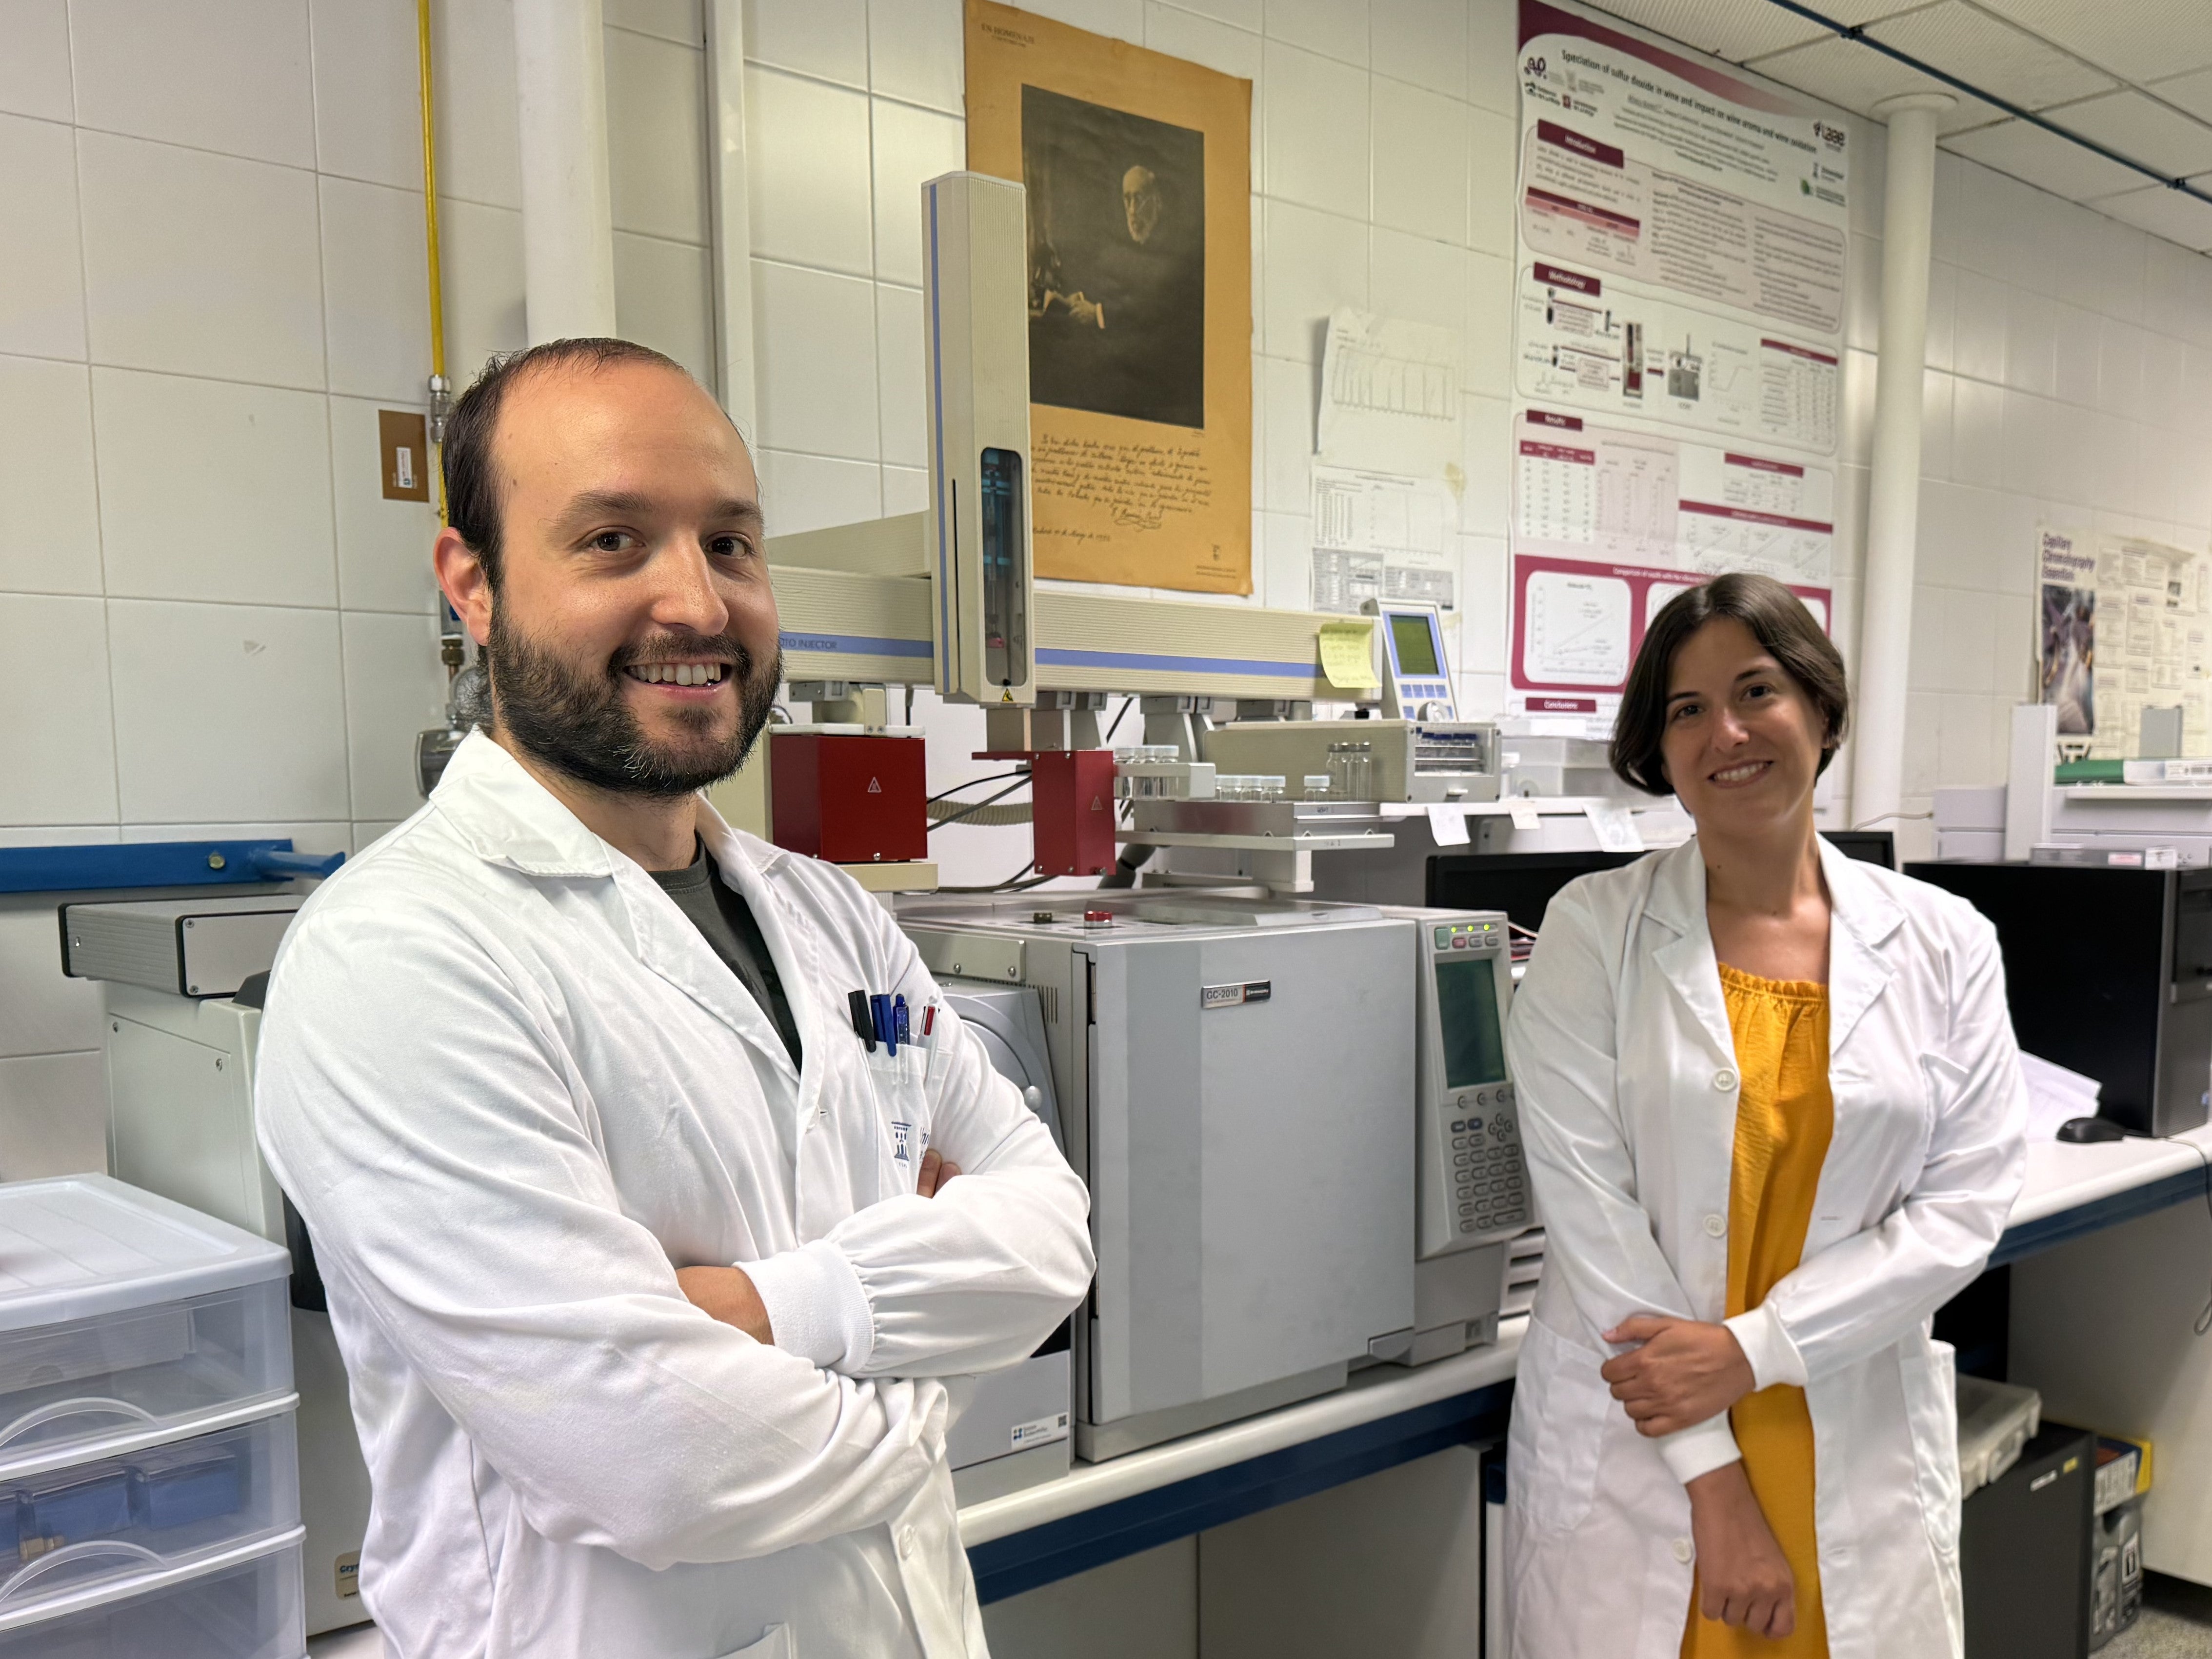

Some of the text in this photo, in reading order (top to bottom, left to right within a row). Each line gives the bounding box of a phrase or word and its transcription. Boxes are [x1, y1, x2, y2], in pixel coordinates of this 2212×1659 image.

[1602, 64, 1609, 73] of
[1664, 90, 1679, 102] wine
[798, 640, 837, 649] INJECTOR
[1207, 988, 1238, 1000] GC-2010
